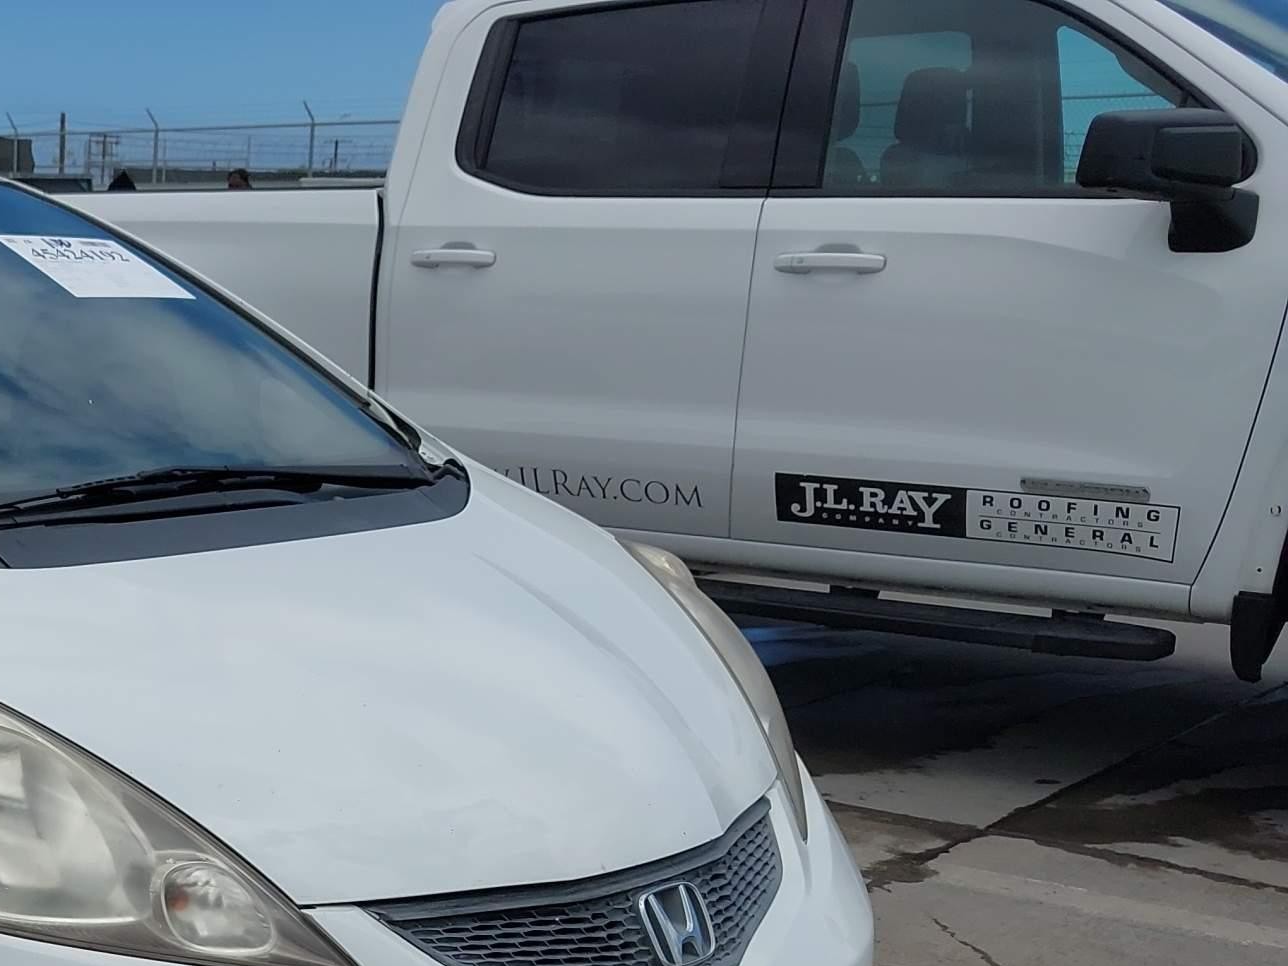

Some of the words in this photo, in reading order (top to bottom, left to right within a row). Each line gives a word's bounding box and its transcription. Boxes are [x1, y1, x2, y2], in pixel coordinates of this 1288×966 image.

[31, 247, 131, 263] 45424192
[495, 466, 704, 508] JLRAY.COM
[821, 511, 914, 527] COMPANY
[981, 494, 1161, 522] ROOFING
[995, 508, 1144, 529] CONTRACTORS
[978, 519, 1160, 549] GENERAL
[994, 531, 1142, 553] CONTRACTORS
